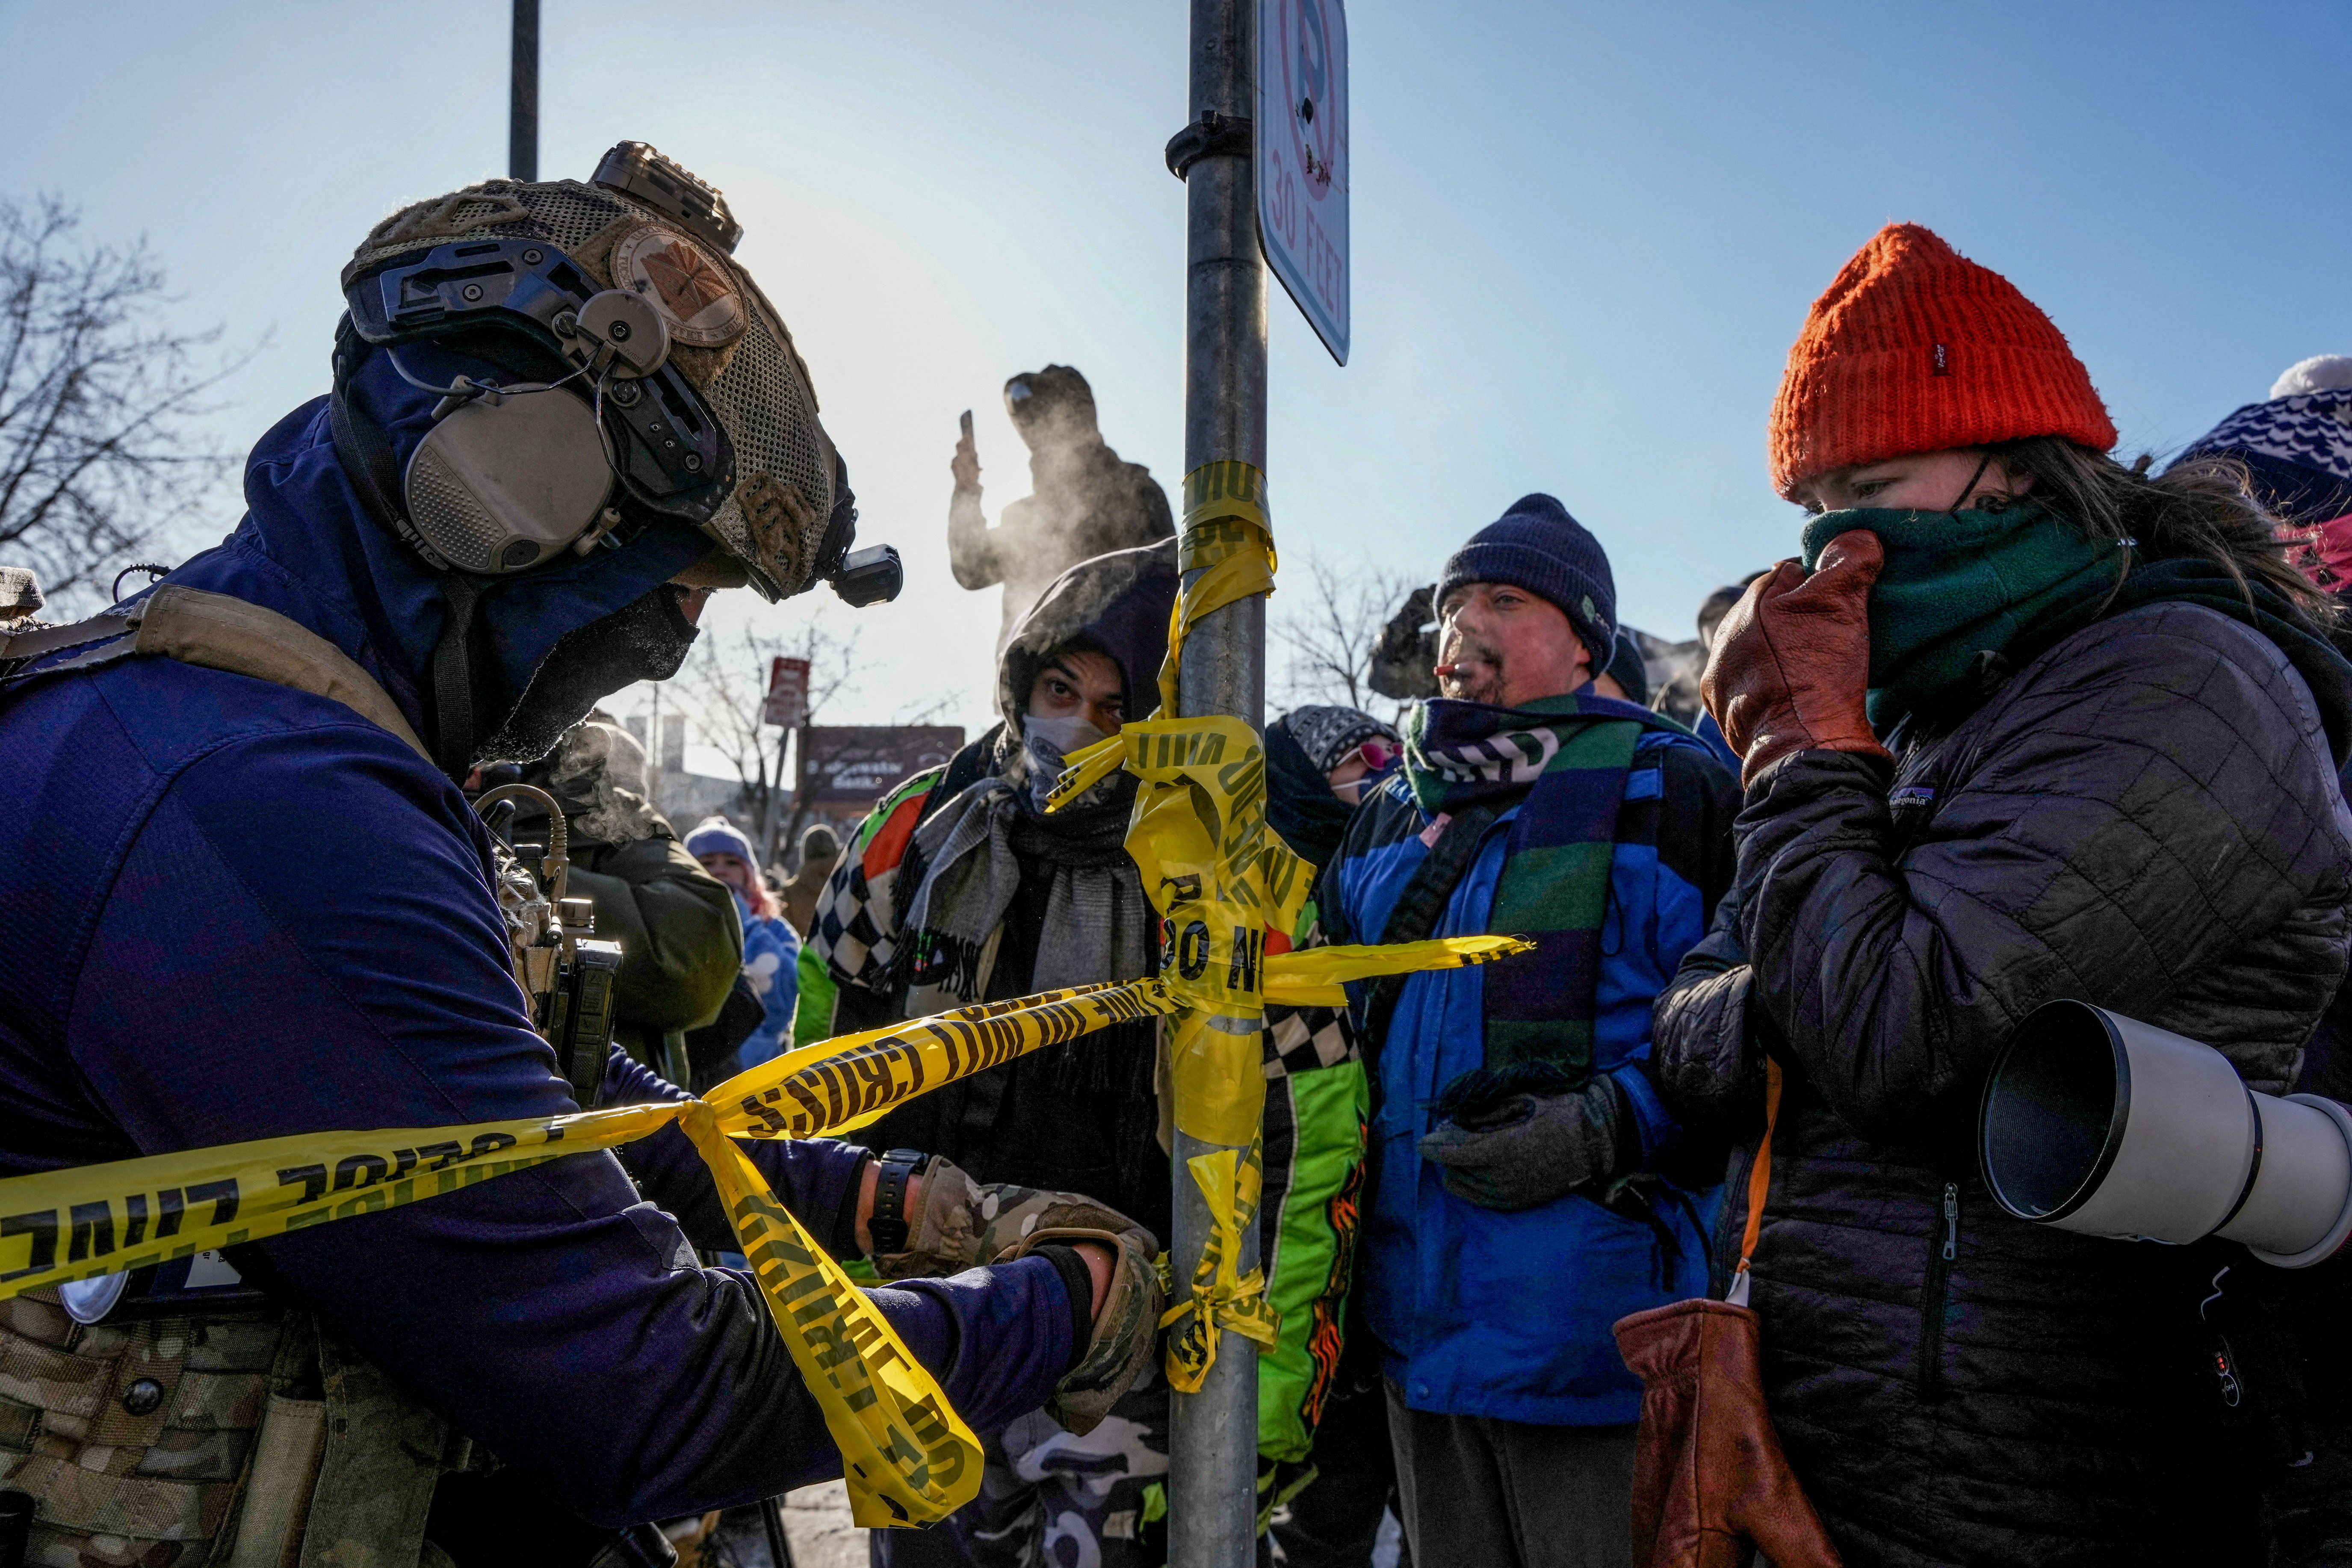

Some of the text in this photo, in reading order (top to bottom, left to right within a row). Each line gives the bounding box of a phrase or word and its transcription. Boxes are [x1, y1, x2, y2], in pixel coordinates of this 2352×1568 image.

[1272, 149, 1342, 323] 30 FEET
[621, 345, 644, 366] INVISIO
[424, 451, 453, 482] INVISIO
[742, 1033, 925, 1140] CROSS
[0, 1178, 239, 1284] LINE
